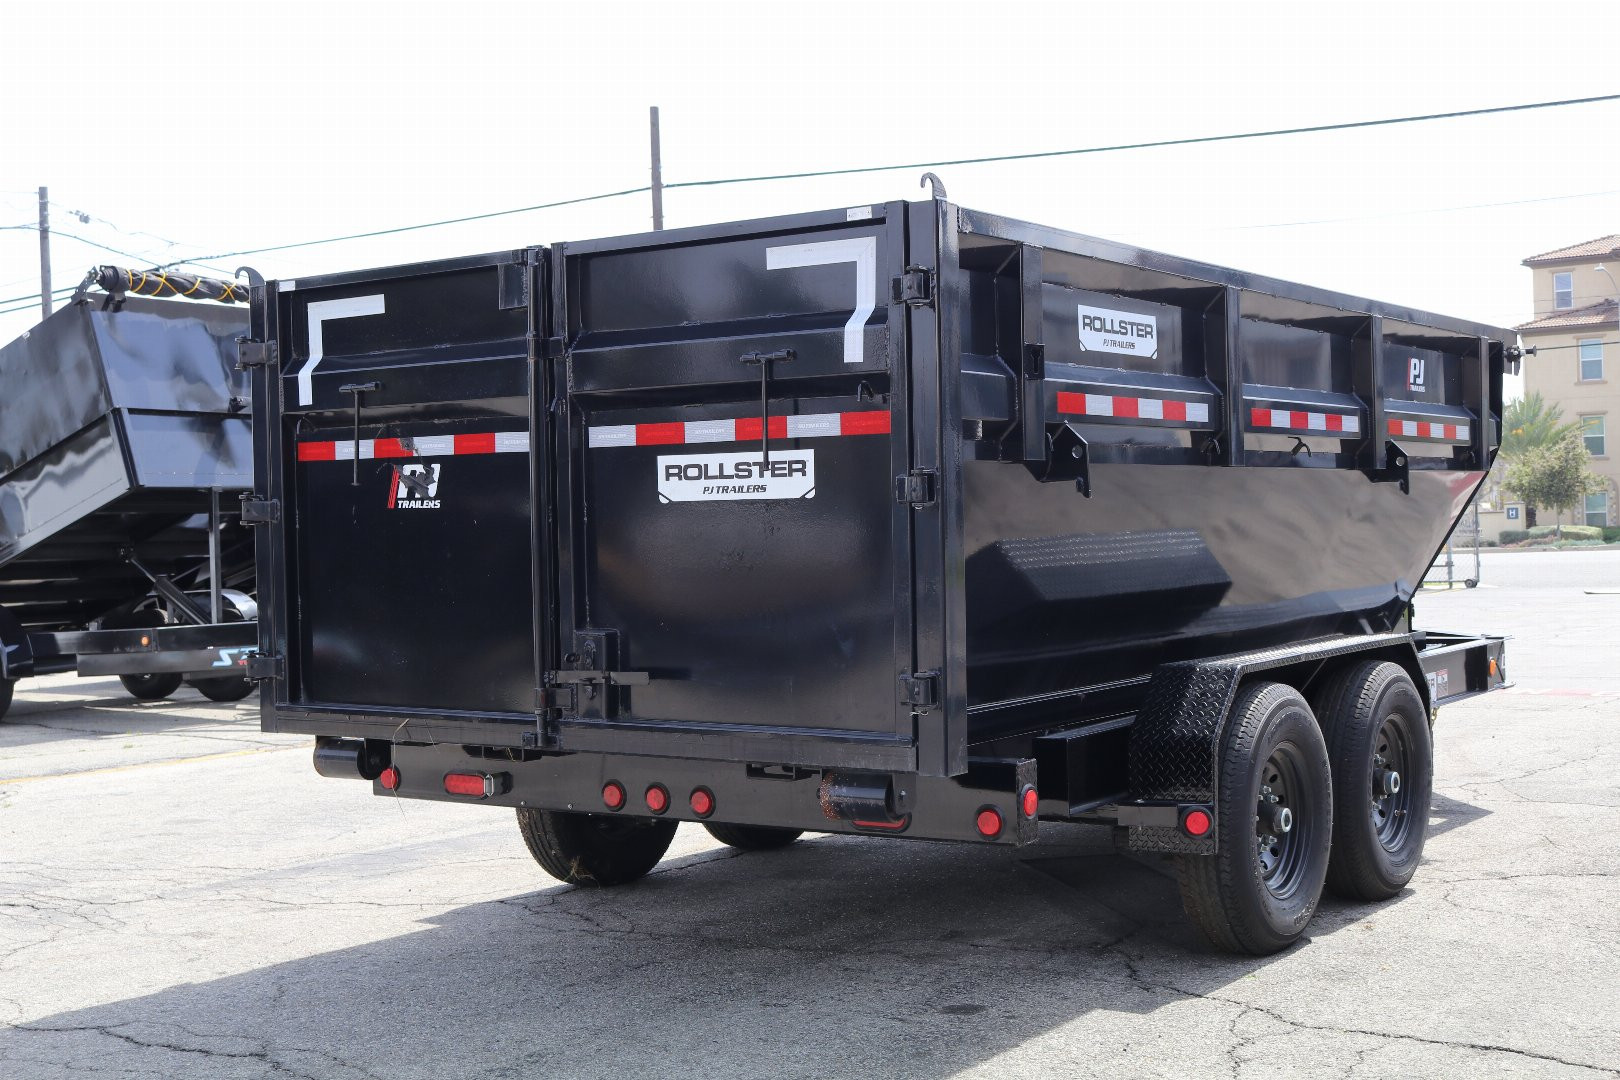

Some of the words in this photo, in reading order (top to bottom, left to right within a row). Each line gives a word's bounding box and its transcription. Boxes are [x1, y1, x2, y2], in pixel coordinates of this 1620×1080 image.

[1082, 314, 1154, 339] ROLLSTER
[1110, 339, 1136, 350] TRAILERS
[1410, 358, 1425, 385] PJ
[664, 459, 808, 482] ROLLSTER
[702, 486, 715, 495] PJ
[715, 484, 768, 494] TRAILERS
